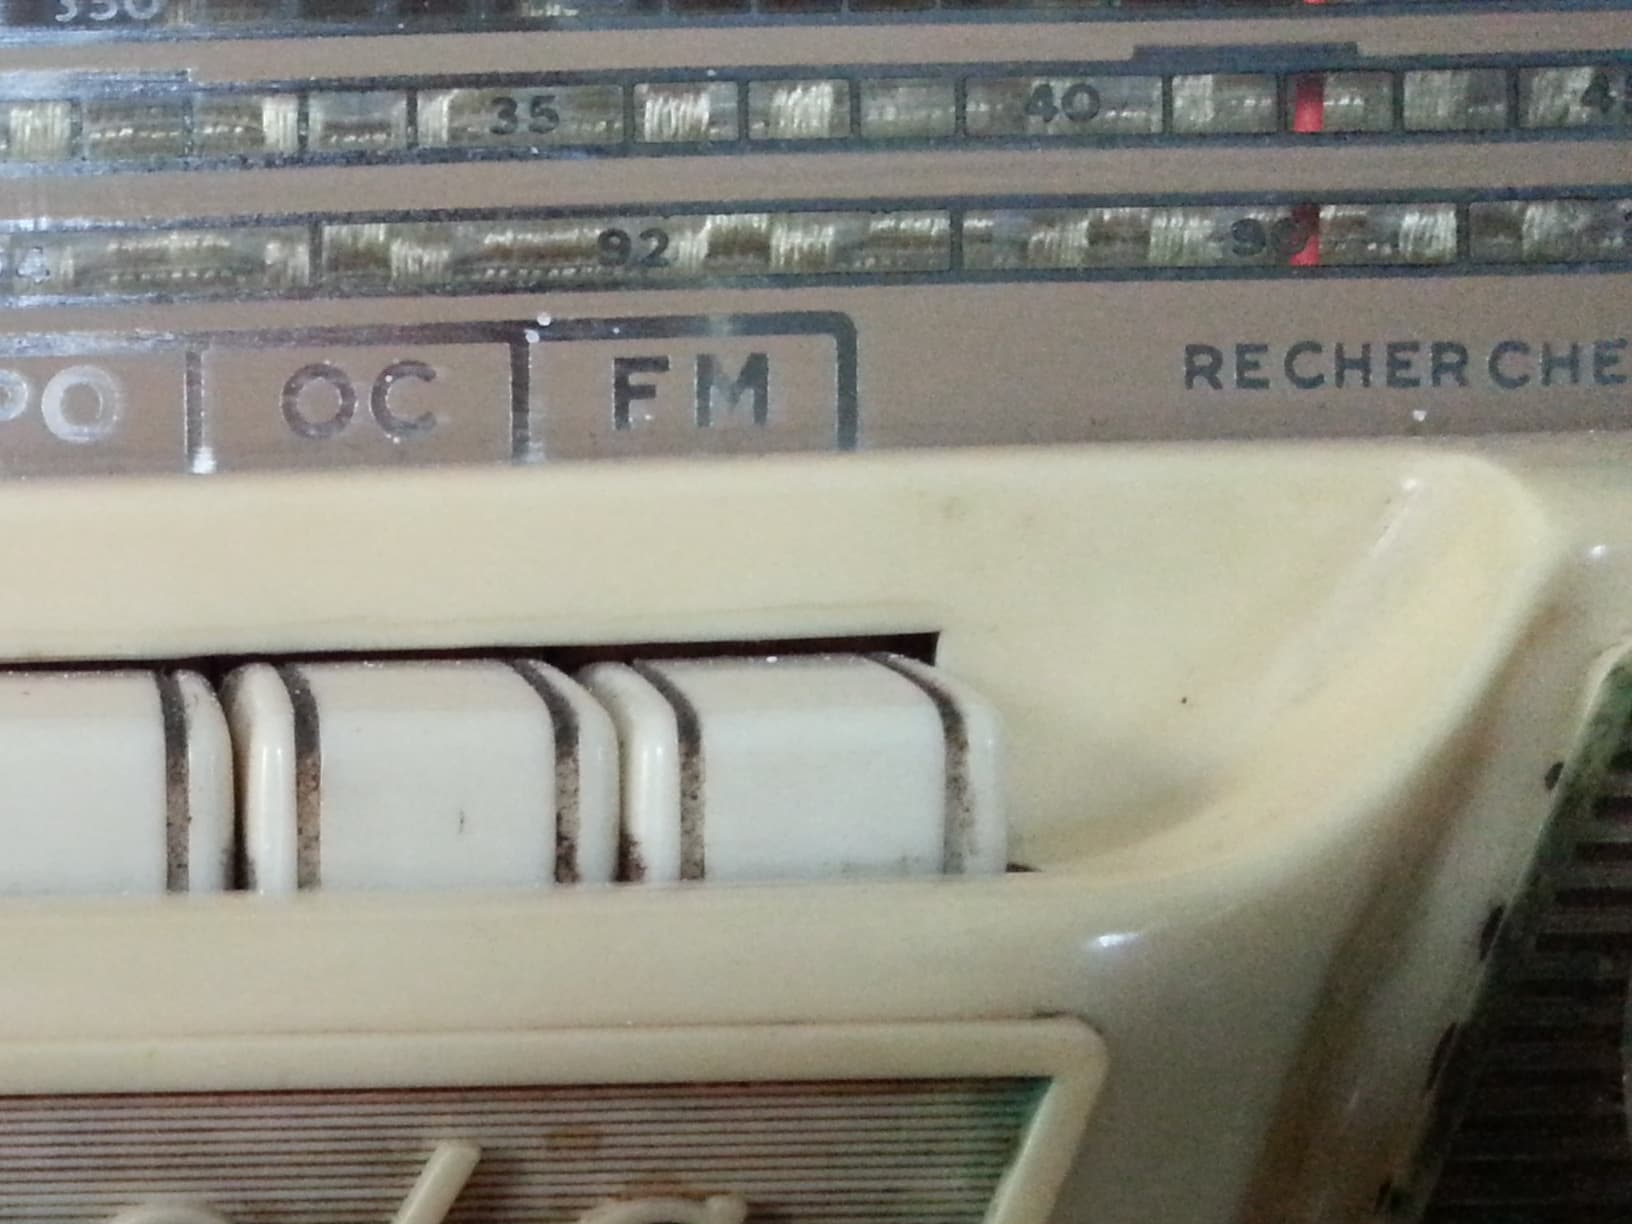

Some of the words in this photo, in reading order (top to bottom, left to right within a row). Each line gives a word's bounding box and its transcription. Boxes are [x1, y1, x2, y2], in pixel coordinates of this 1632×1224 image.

[489, 96, 561, 135] 35
[1023, 82, 1102, 124] 40
[597, 228, 671, 269] 92
[1184, 338, 1632, 392] RECHERCHE
[279, 360, 439, 442] OC
[612, 352, 770, 433] FM
